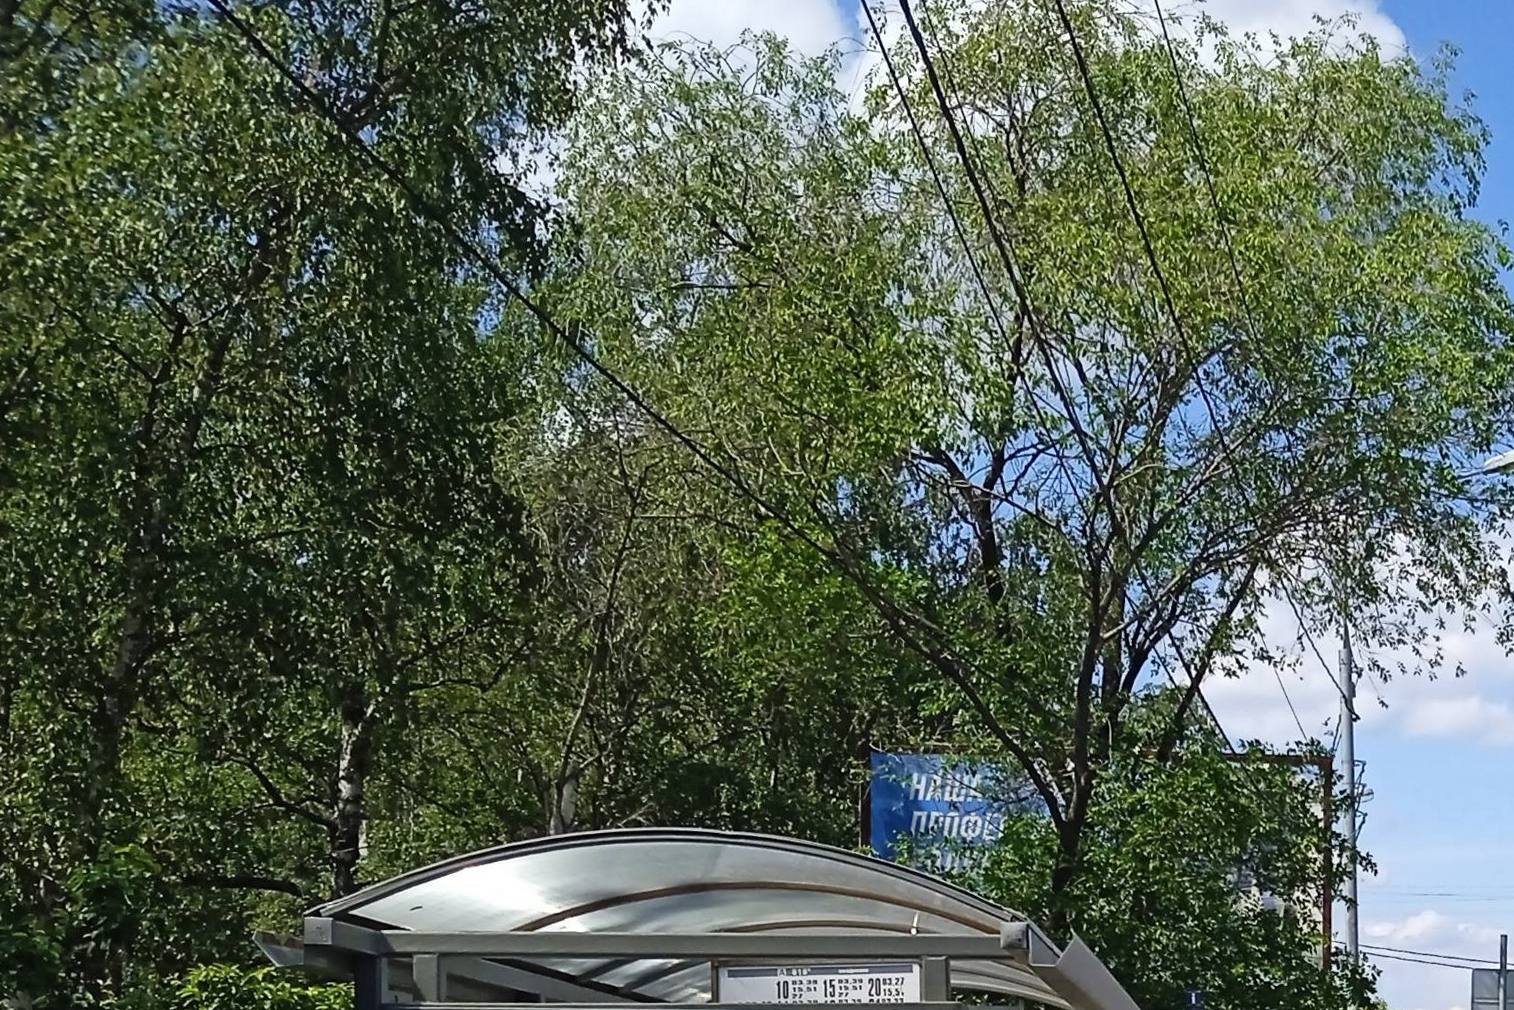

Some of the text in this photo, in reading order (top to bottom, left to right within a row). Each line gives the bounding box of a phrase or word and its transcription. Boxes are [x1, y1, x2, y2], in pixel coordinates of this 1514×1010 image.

[776, 978, 881, 999] 10 15 20
